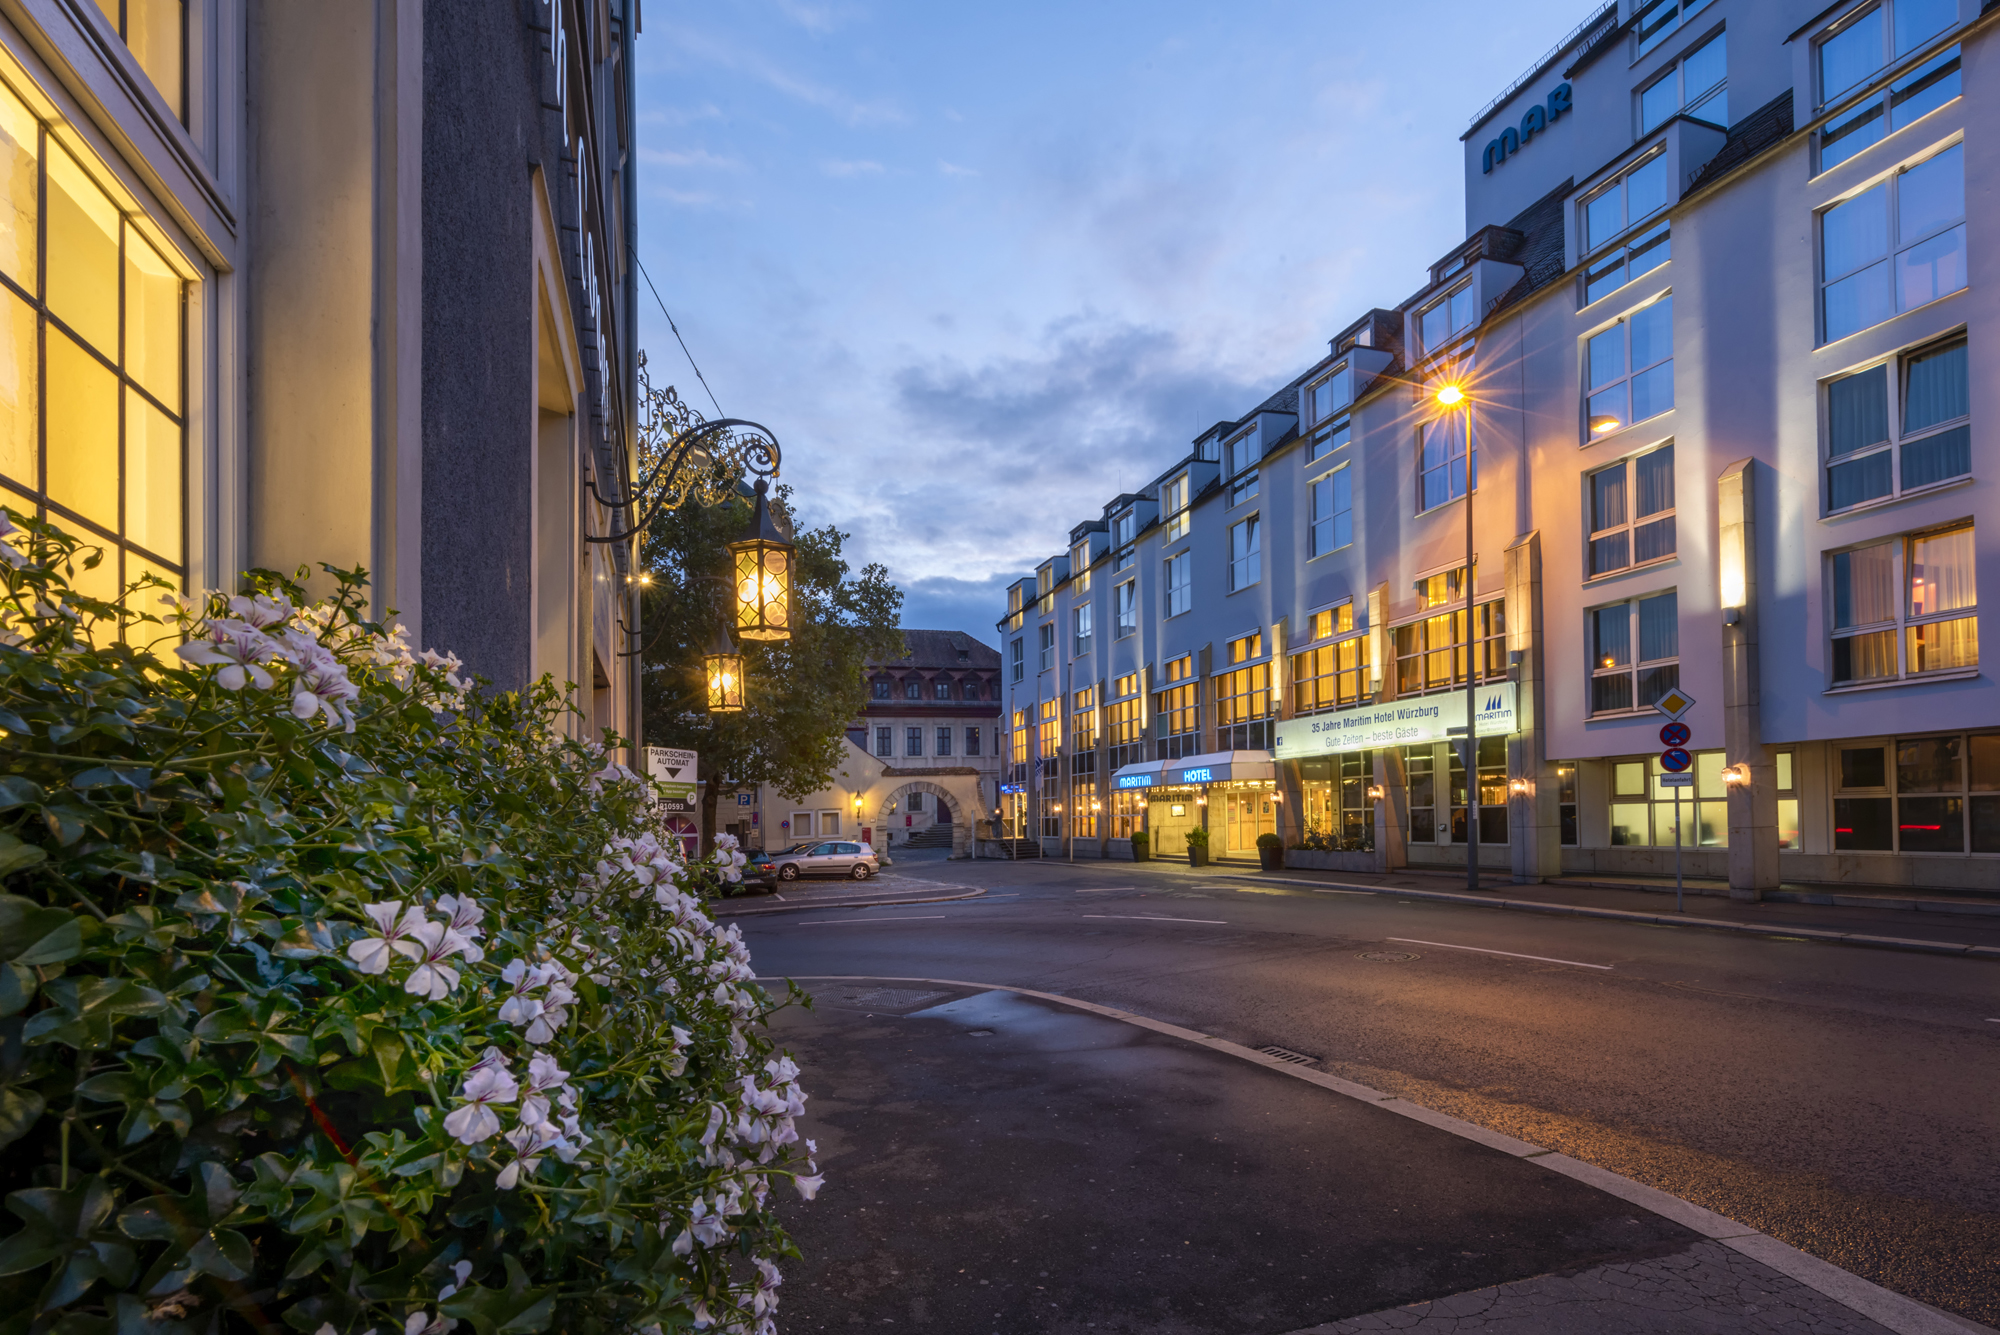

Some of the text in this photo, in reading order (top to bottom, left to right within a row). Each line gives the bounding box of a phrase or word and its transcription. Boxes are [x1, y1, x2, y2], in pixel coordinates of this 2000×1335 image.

[1311, 706, 1439, 733] 35 Jahre Maritim Hotel Würzburg
[1475, 709, 1512, 721] MARITIM
[1325, 736, 1341, 747] Gute
[1342, 734, 1364, 745] Zeiten
[1372, 730, 1393, 741] beste
[1395, 727, 1418, 739] Gäste
[650, 748, 696, 760] PARKSCHEIN-
[657, 758, 690, 767] AUTOMAT
[1120, 775, 1152, 788] MARITIM
[1184, 769, 1212, 782] HOTEL
[740, 795, 748, 805] P
[1150, 794, 1193, 803] MARITIM
